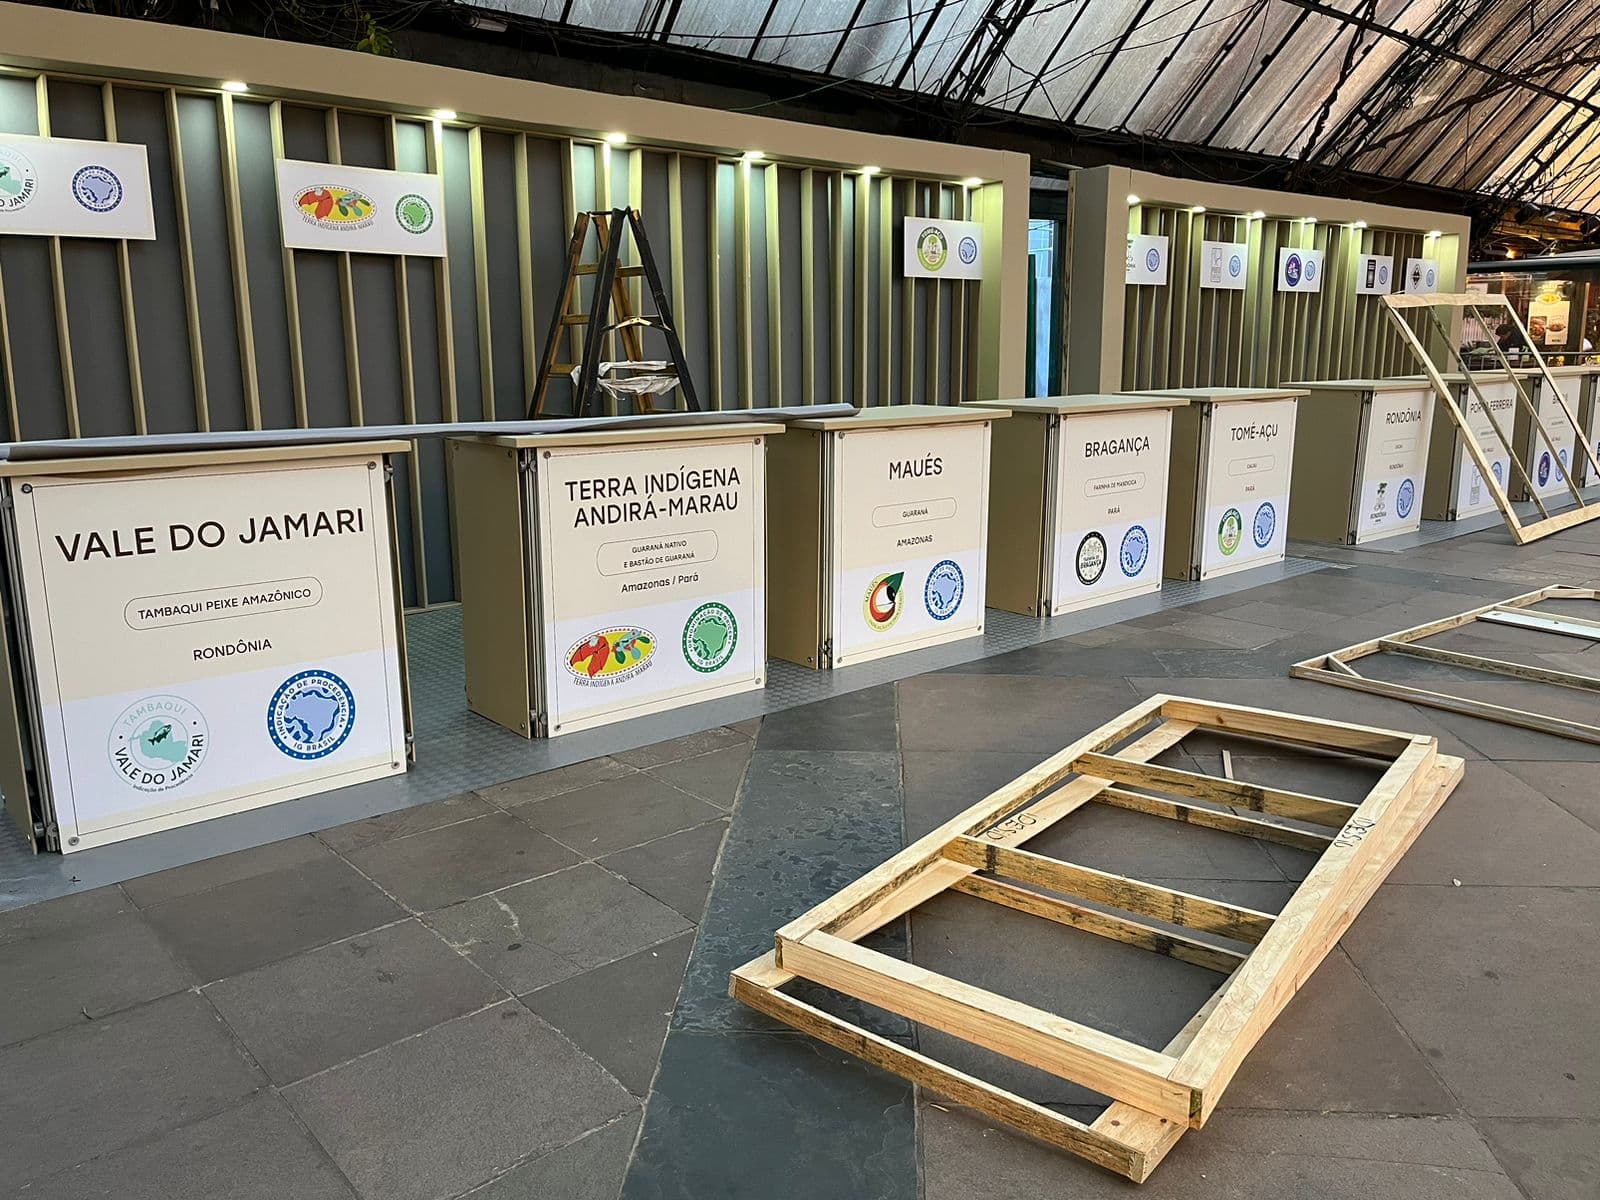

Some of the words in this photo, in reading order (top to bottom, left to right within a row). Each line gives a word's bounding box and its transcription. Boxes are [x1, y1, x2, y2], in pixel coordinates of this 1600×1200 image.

[9, 178, 34, 208] JAMARI
[1385, 407, 1422, 424] RONDÔNIA
[1231, 421, 1278, 441] TOMÉ-AÇU
[1085, 436, 1150, 457] BRAGANÇA
[889, 452, 943, 480] MAUÉS
[565, 476, 637, 501] TERRA
[645, 465, 740, 494] INDÍGENA
[574, 492, 738, 528] ANDIRÁ-MARAU
[55, 526, 156, 562] VALE
[169, 521, 225, 551] DO
[238, 508, 364, 544] JAMARI
[631, 542, 663, 553] GUARANÁ
[664, 540, 687, 549] NATIVO
[897, 534, 933, 548] AMAZONAS
[629, 556, 654, 568] BASTÃO
[655, 556, 663, 564] DE
[664, 551, 695, 563] GUARANÁ
[621, 578, 670, 593] Amazonas
[672, 575, 676, 585] /
[678, 572, 699, 584] Pará
[138, 602, 202, 620] TAMBAQUI
[206, 598, 238, 611] PEIXE
[241, 588, 311, 607] AMAZÔNICO
[193, 638, 272, 661] RONDÔNIA
[124, 702, 188, 727] TAMBAQUI
[277, 687, 295, 736] INDICAÇÃO
[297, 680, 308, 688] DE
[306, 736, 336, 751] BRASIL
[115, 746, 142, 780] VALE
[141, 772, 165, 784] DO
[171, 734, 204, 781] JAMARI
